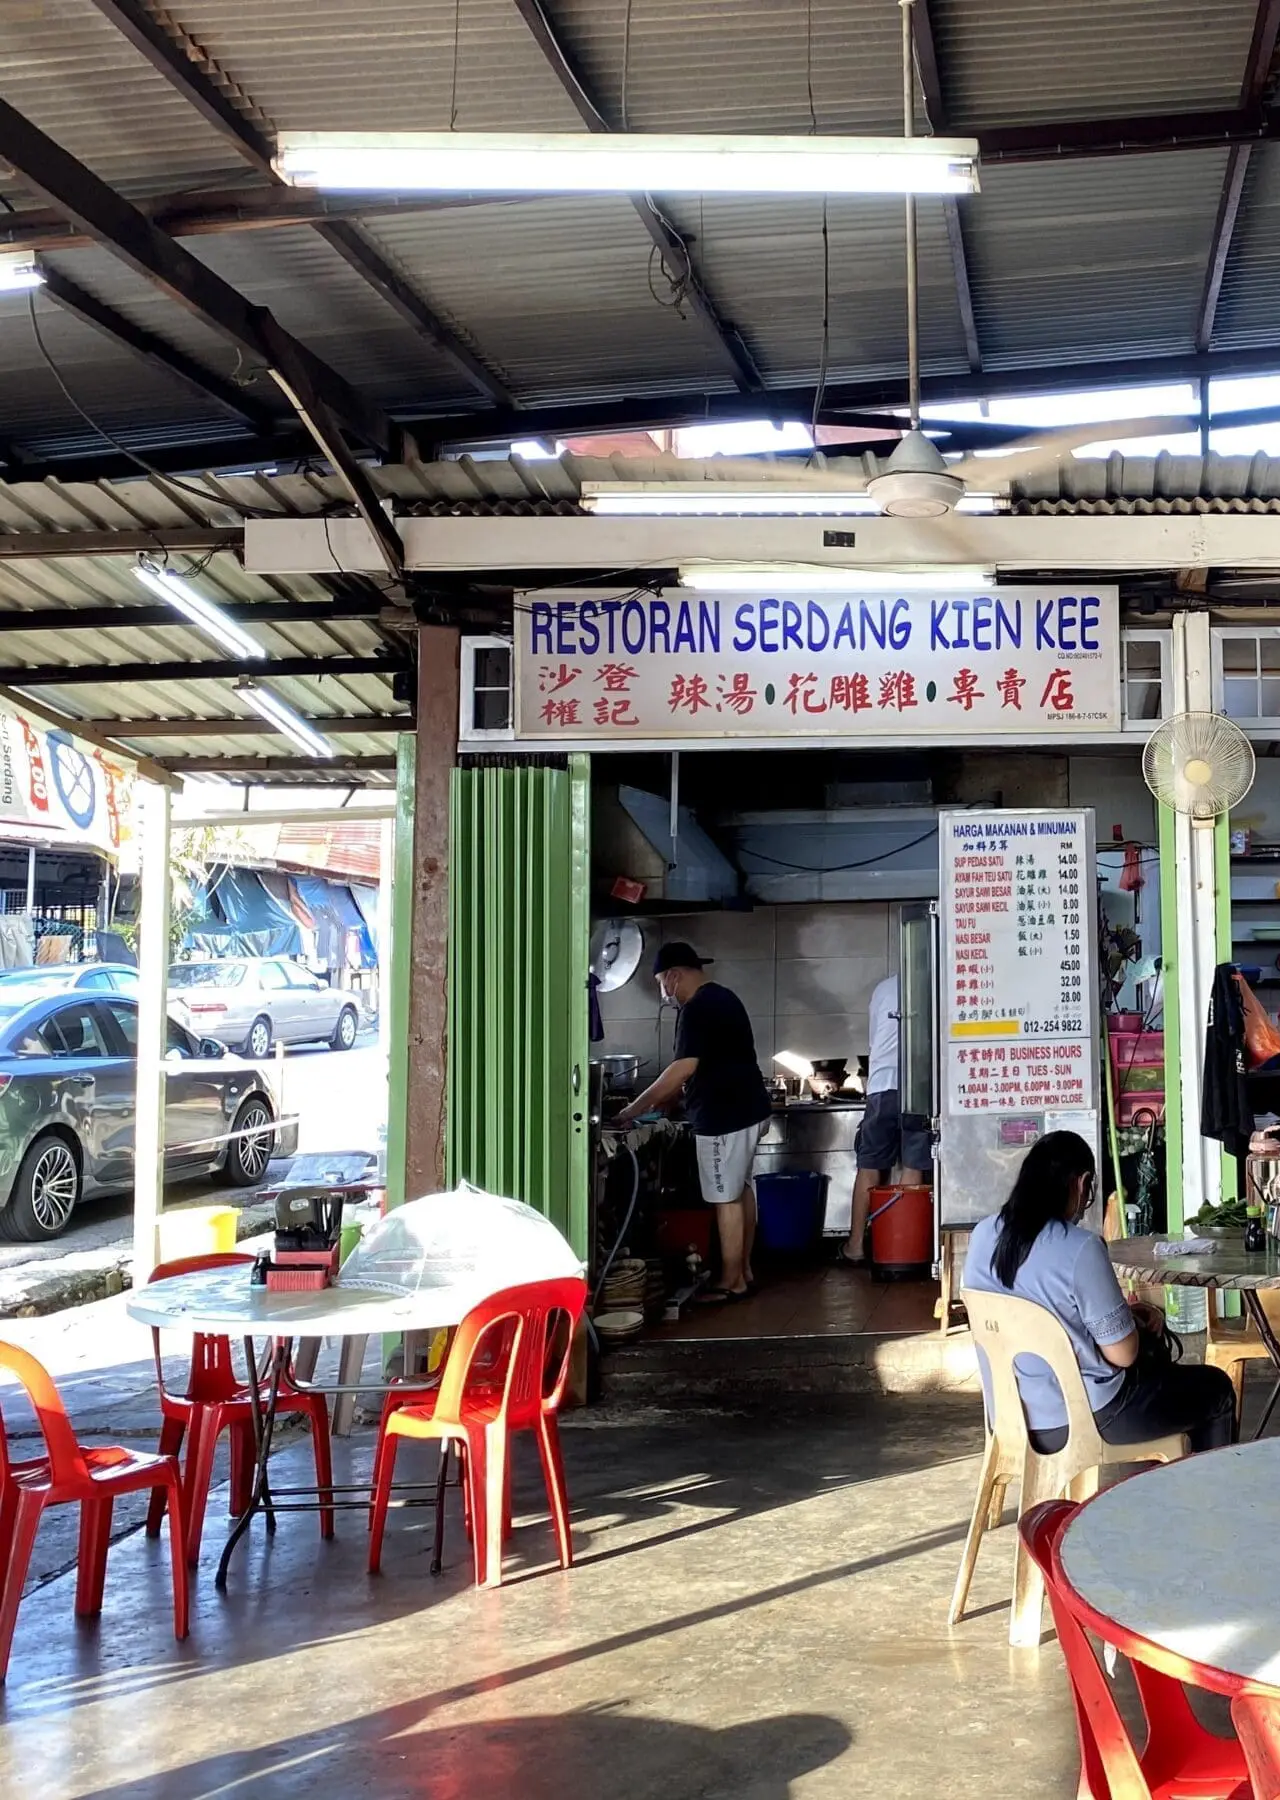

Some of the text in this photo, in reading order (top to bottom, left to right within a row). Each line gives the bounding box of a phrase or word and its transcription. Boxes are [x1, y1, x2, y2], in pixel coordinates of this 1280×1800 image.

[531, 596, 1101, 655] RESTORAN SERDANG KIEN KEE
[2, 744, 14, 805] Serdang
[953, 822, 1077, 838] HARGA MAKANAN & MINUMAN
[1060, 842, 1073, 850] RM
[954, 855, 1004, 868] SUP PEDAS SATU
[1058, 854, 1077, 865] 14.00
[954, 872, 971, 883] AYAM
[997, 871, 1013, 882] SATU
[1058, 869, 1078, 880] 14.00
[954, 887, 974, 899] SAYUR
[991, 886, 1012, 897] BESAR
[1058, 884, 1078, 895] 14.00
[954, 902, 974, 914] SAYUR
[991, 901, 1009, 912] KECIL
[1063, 899, 1079, 910] 8.00
[956, 918, 967, 929] TAU
[1062, 914, 1079, 925] 7.00
[955, 933, 991, 945] NASI BESAR
[1064, 929, 1080, 940] 1.50
[955, 948, 988, 961] NASI KECIL
[1064, 944, 1080, 955] 1.00
[1060, 976, 1081, 986] 32.00
[1061, 991, 1081, 1002] 28.00
[1024, 1019, 1082, 1033] 012-254 9822
[1010, 1045, 1082, 1060] BUSINESS HOURS
[1027, 1065, 1048, 1076] TUES
[1055, 1064, 1072, 1075] SUN
[1024, 1081, 1050, 1092] 6.00PM
[1056, 1079, 1082, 1090] 9.00PM
[1021, 1093, 1083, 1106] EVERY MON CLOSE
